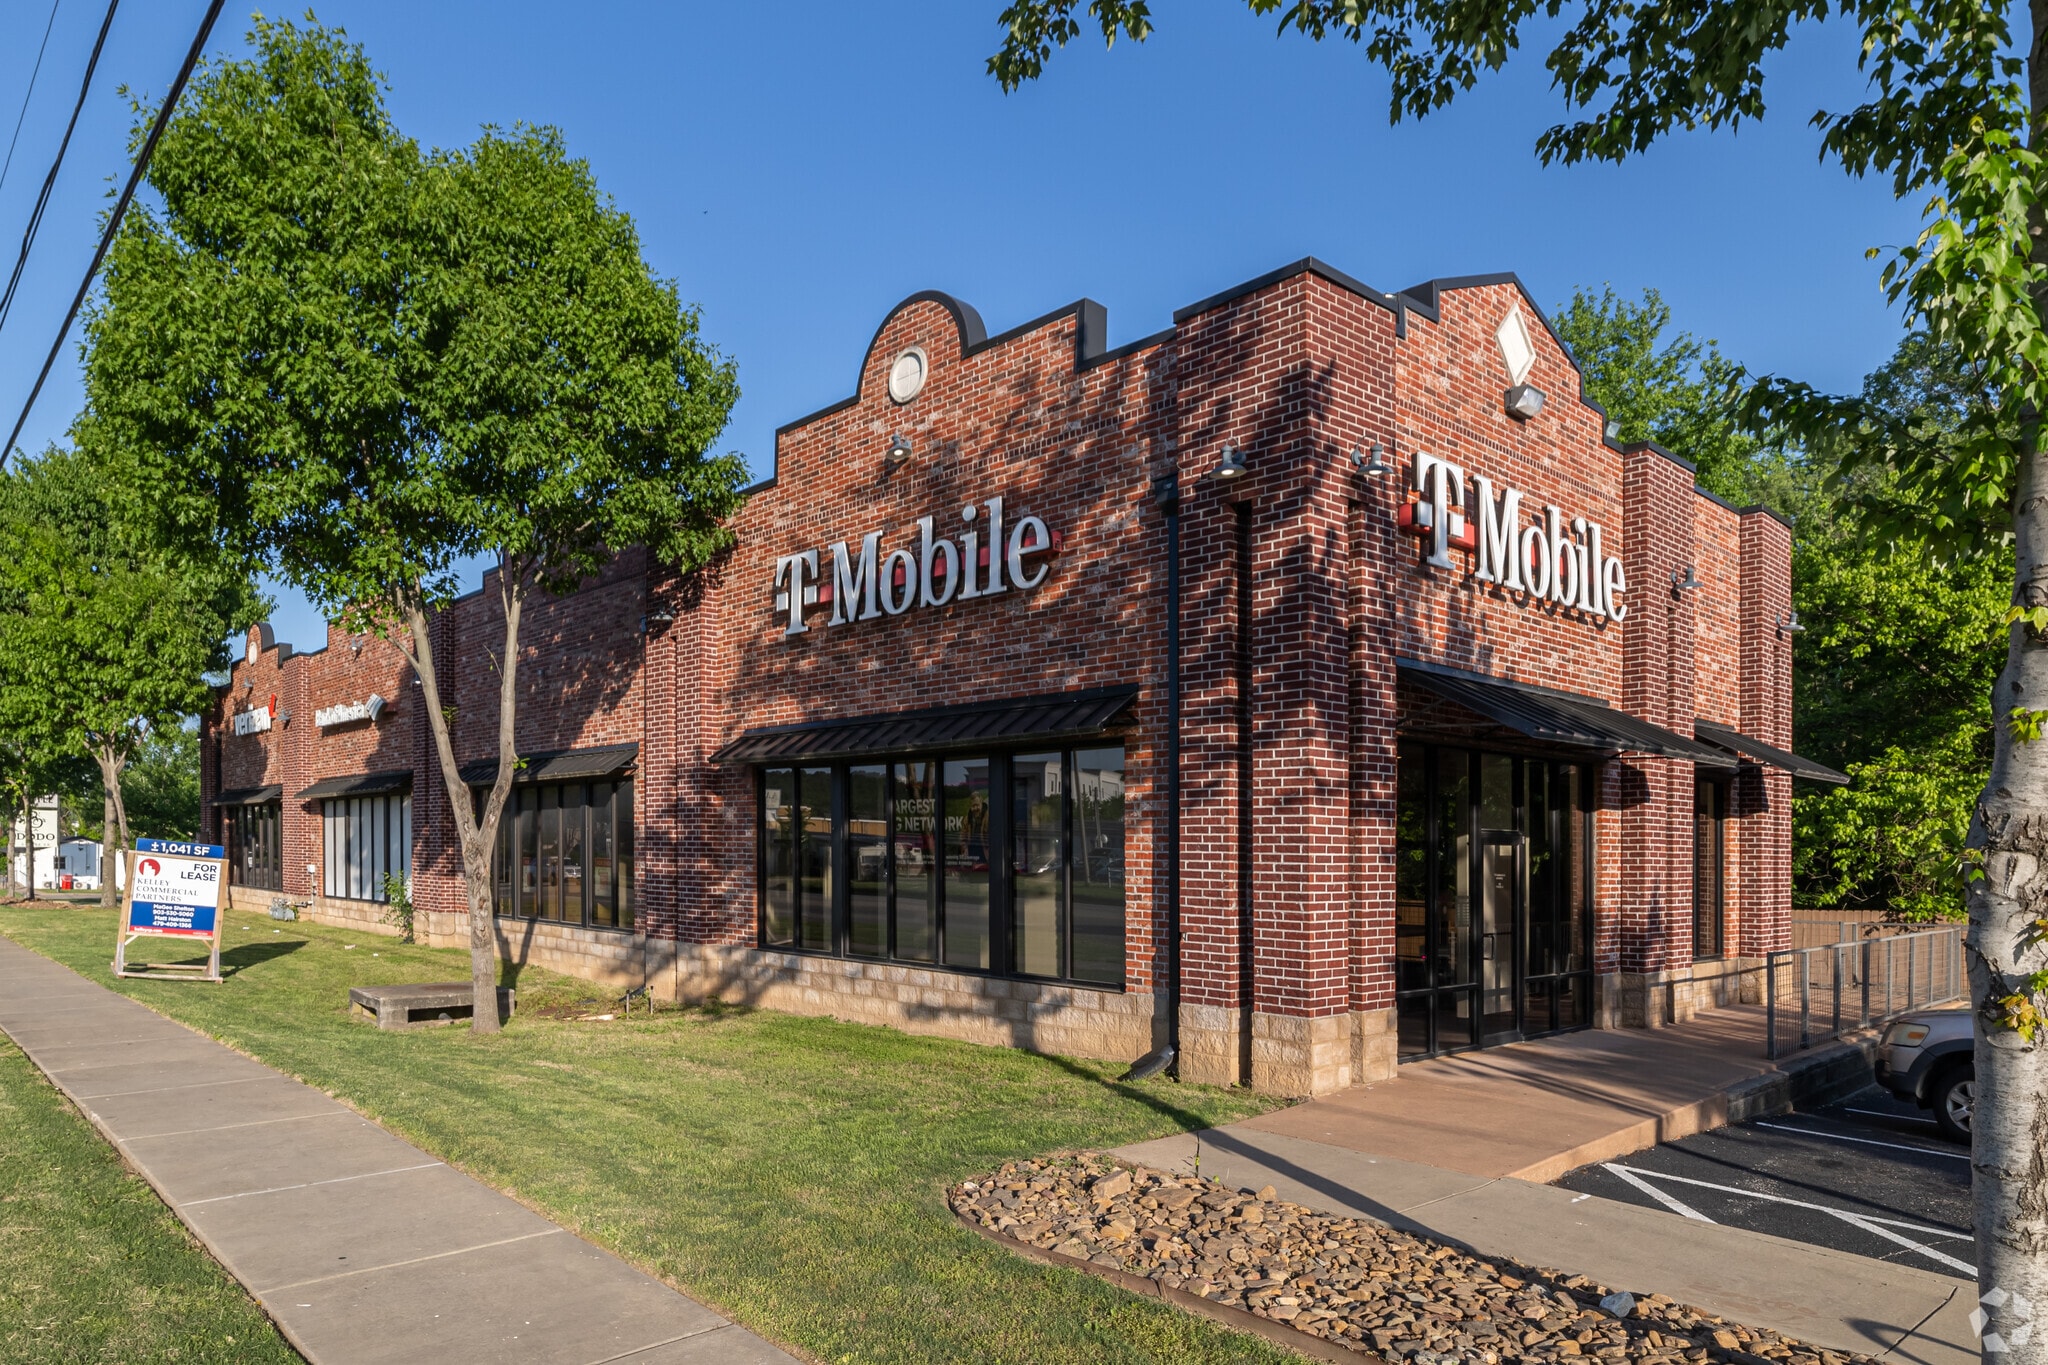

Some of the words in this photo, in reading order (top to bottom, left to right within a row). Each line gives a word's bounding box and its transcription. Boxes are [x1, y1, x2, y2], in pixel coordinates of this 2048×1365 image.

[895, 798, 936, 814] ARGEST
[194, 845, 210, 856] SF
[193, 863, 217, 873] FOR
[137, 878, 170, 886] KELLEY
[180, 871, 216, 882] LEASE
[136, 885, 199, 896] COMMERCIAL
[135, 893, 182, 902] PARTNERS
